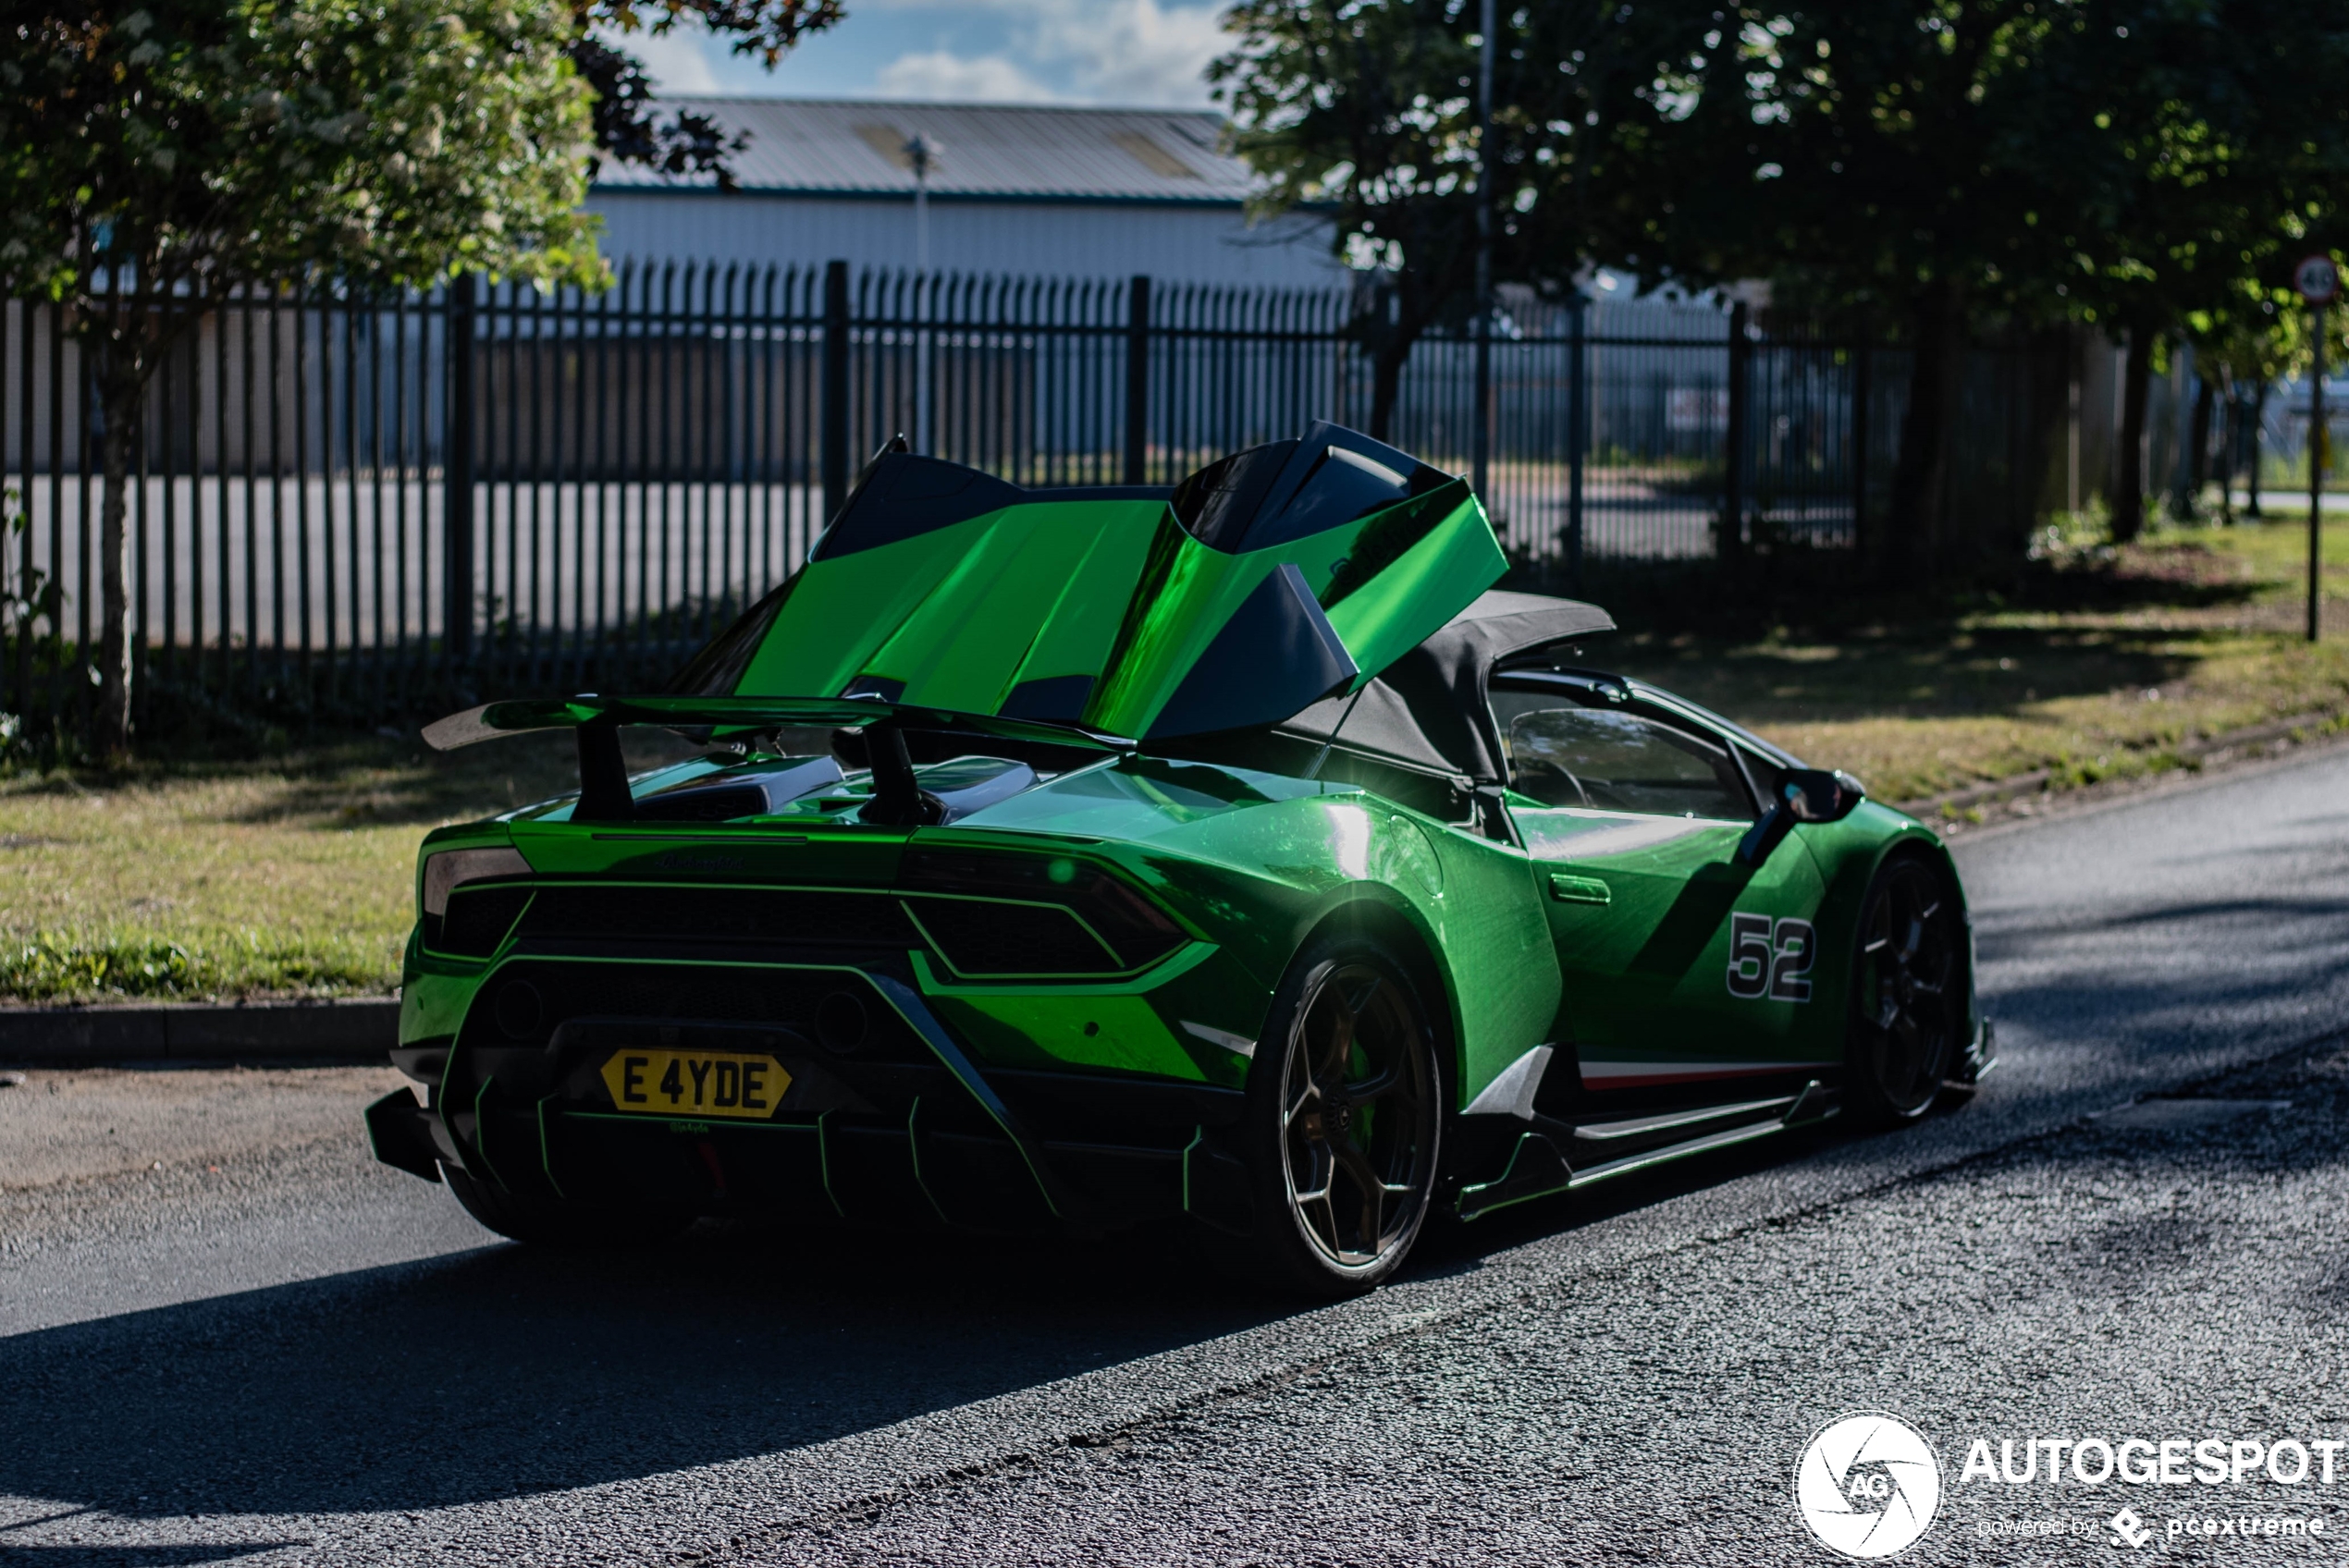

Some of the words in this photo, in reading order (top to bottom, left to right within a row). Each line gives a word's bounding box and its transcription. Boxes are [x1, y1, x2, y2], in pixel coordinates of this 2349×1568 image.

[2302, 265, 2332, 288] 40
[655, 852, 744, 873] Lamborghini
[1726, 911, 1816, 1003] 52
[623, 1057, 649, 1103] E
[659, 1059, 768, 1109] 4YDE
